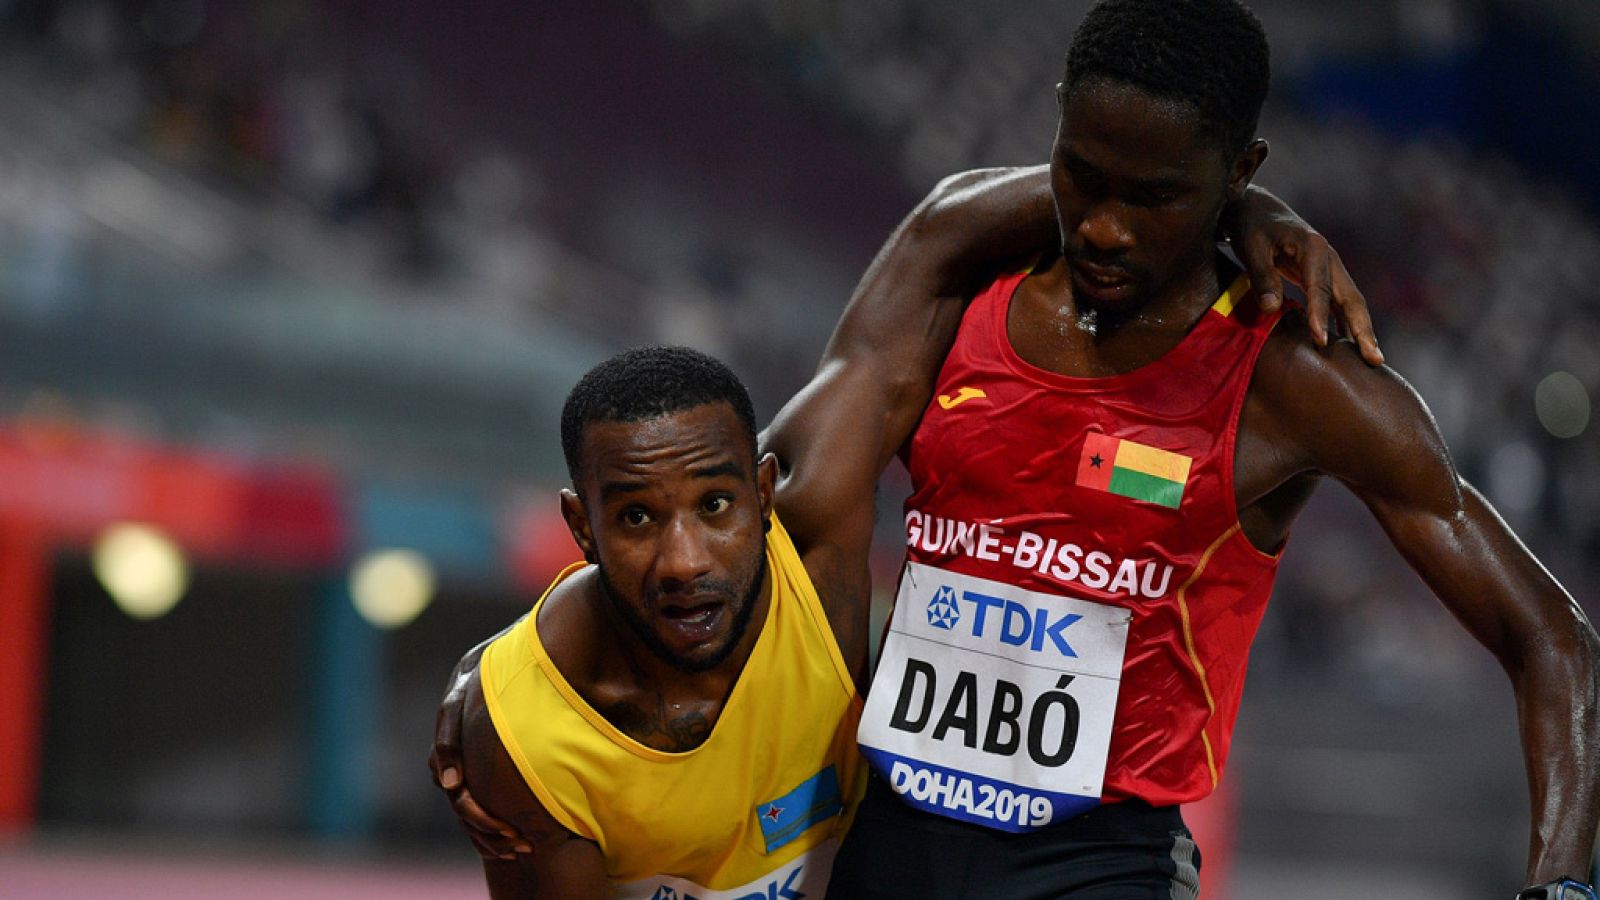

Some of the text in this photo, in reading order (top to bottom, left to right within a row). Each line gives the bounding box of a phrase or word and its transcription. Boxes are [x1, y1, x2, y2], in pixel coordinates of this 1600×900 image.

[905, 510, 1173, 597] GUINÉ-BISSAU
[963, 591, 1083, 658] TDK
[889, 658, 1080, 767] DABÓ
[890, 761, 1053, 827] DOHA2019
